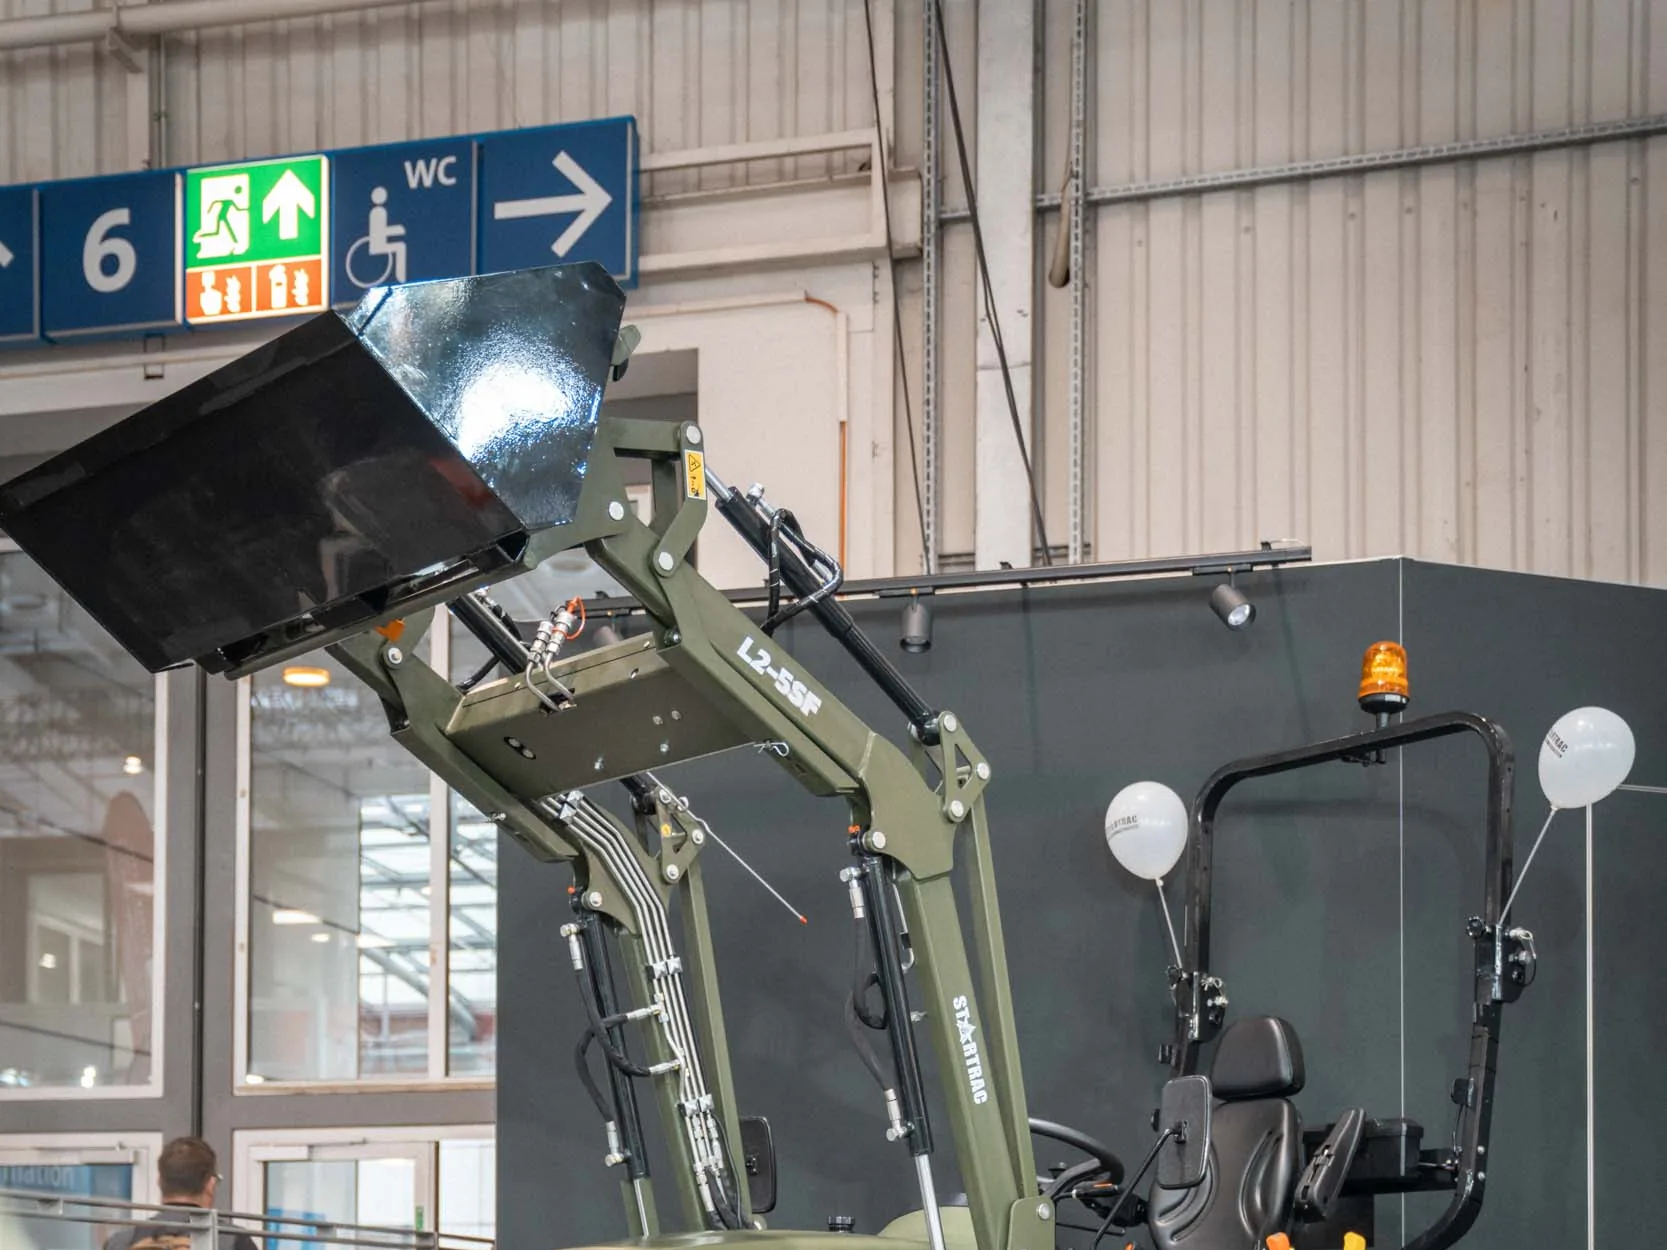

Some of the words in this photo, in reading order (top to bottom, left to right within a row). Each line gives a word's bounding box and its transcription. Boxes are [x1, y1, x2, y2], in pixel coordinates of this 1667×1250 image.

[403, 155, 457, 189] WC
[83, 207, 137, 293] 6
[736, 636, 822, 717] L2-5SF
